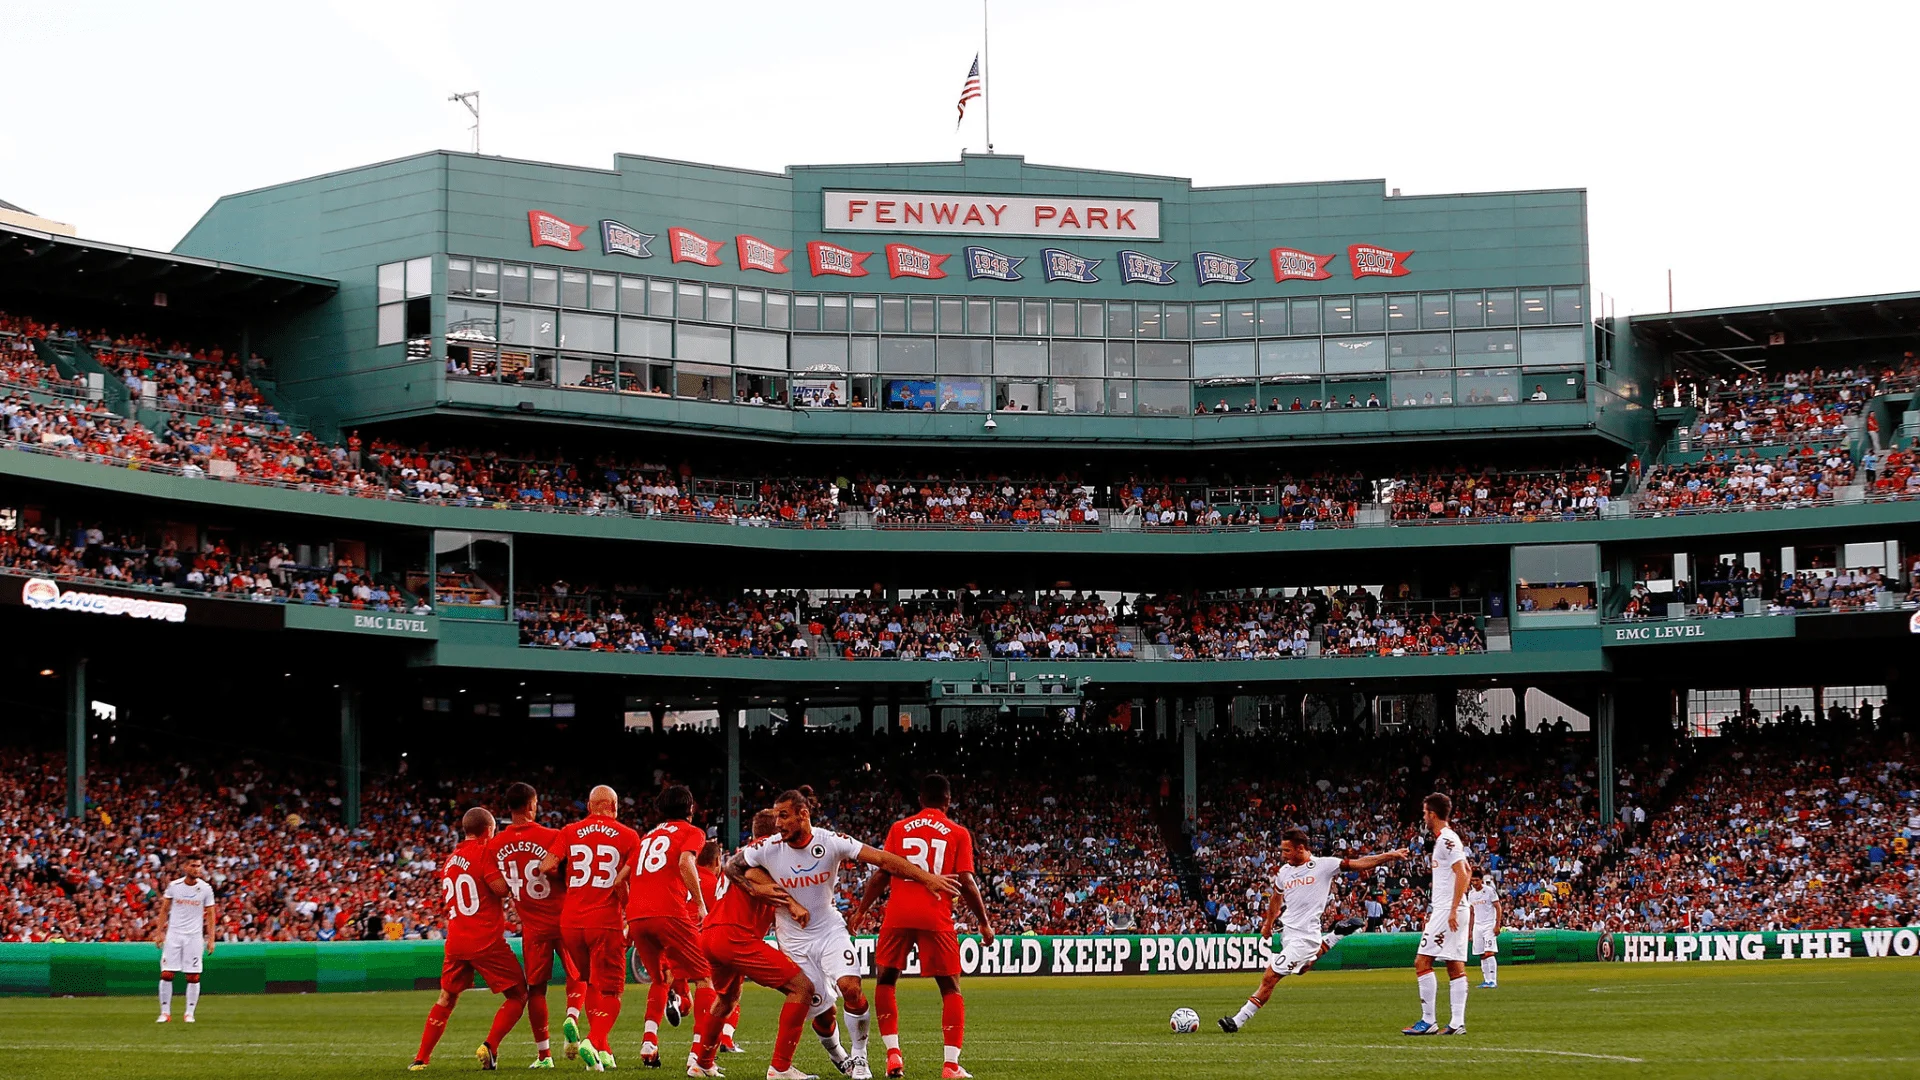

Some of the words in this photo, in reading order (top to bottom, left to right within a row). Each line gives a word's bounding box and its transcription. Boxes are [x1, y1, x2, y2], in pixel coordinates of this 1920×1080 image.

[848, 200, 1007, 225] FENWAY
[1034, 205, 1137, 230] PARK
[539, 220, 571, 242] 1903
[609, 229, 641, 250] 1904
[680, 237, 708, 257] 1912
[747, 244, 775, 265] 1915
[820, 250, 853, 269] 1916
[898, 252, 930, 271] 1918
[974, 254, 1009, 274] 1946
[1051, 257, 1086, 276] 1967
[1128, 258, 1162, 277] 1975
[1203, 259, 1238, 277] 1986
[1280, 257, 1316, 274] 2004
[1356, 253, 1395, 270] 2007
[977, 268, 1007, 279] CHAMPIONS
[1054, 271, 1084, 281] CHAMPIONS
[1131, 272, 1160, 282] CHAMPIONS
[1206, 273, 1237, 281] CHAMPIONS
[1283, 270, 1314, 278] CHAMPIONS
[1361, 266, 1392, 275] CHAMPIONS
[354, 615, 384, 629] EMC
[387, 618, 428, 632] LEVEL
[1616, 627, 1650, 640] EMC
[1655, 625, 1705, 638] LEVEL
[577, 824, 619, 838] SHELVEY
[904, 818, 951, 835] STERLING
[497, 841, 548, 860] ECCLESTON
[636, 835, 670, 876] 18
[903, 837, 947, 881] 31
[569, 844, 620, 888] 33
[498, 859, 551, 901] 48
[780, 871, 831, 889] WIND
[1284, 876, 1315, 889] WIND
[443, 874, 480, 919] 20
[1623, 934, 1766, 962] HELPING
[1776, 932, 1852, 959] THE
[1862, 929, 1920, 957] WO
[843, 949, 856, 966] 9
[960, 937, 1042, 974] ORLD
[1052, 938, 1131, 973] KEEP
[1140, 937, 1273, 971] PROMISES
